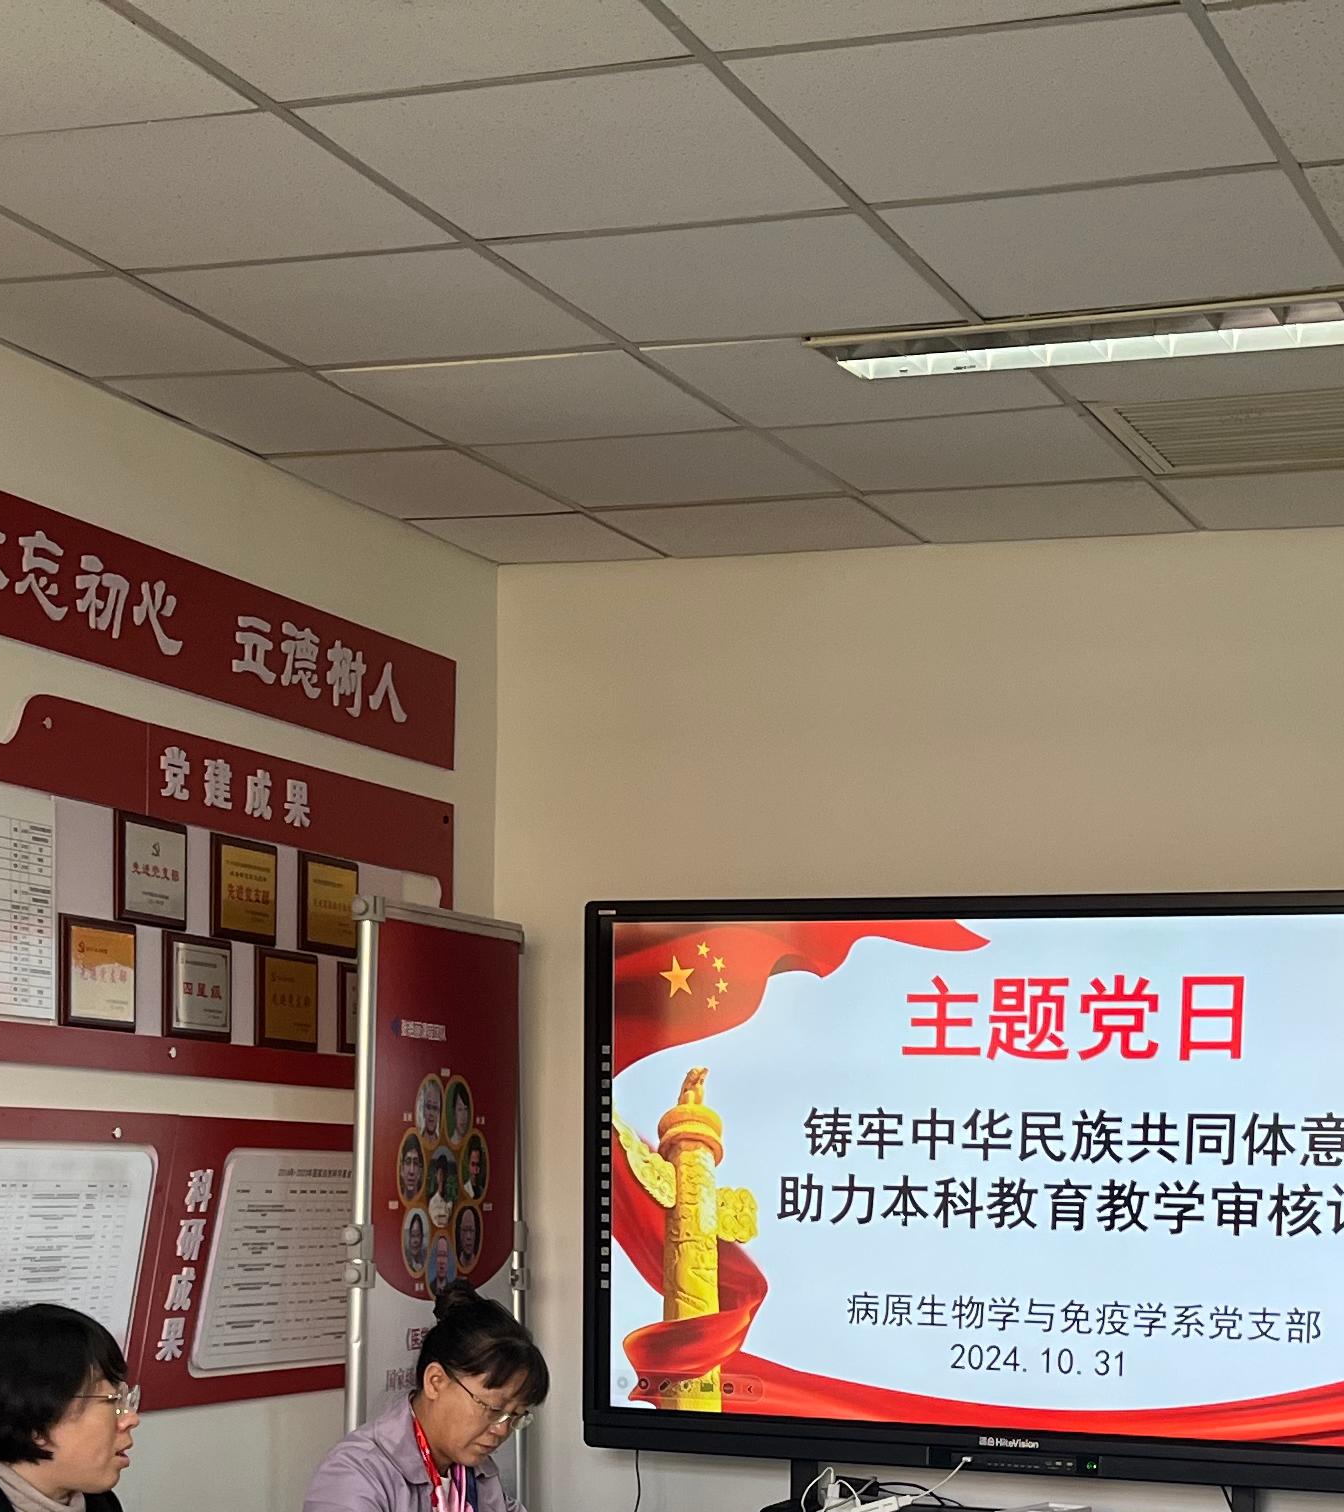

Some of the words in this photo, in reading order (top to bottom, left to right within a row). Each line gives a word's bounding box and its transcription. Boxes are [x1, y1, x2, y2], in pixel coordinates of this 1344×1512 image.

[231, 614, 408, 724] 立德树人
[159, 745, 312, 828] 党建成果
[901, 973, 1248, 1061] 主题党日
[155, 1168, 213, 1361] 科研成果
[846, 1292, 1322, 1342] 病原生物学与免疫学系党支部
[996, 1438, 1039, 1448] HiteVision
